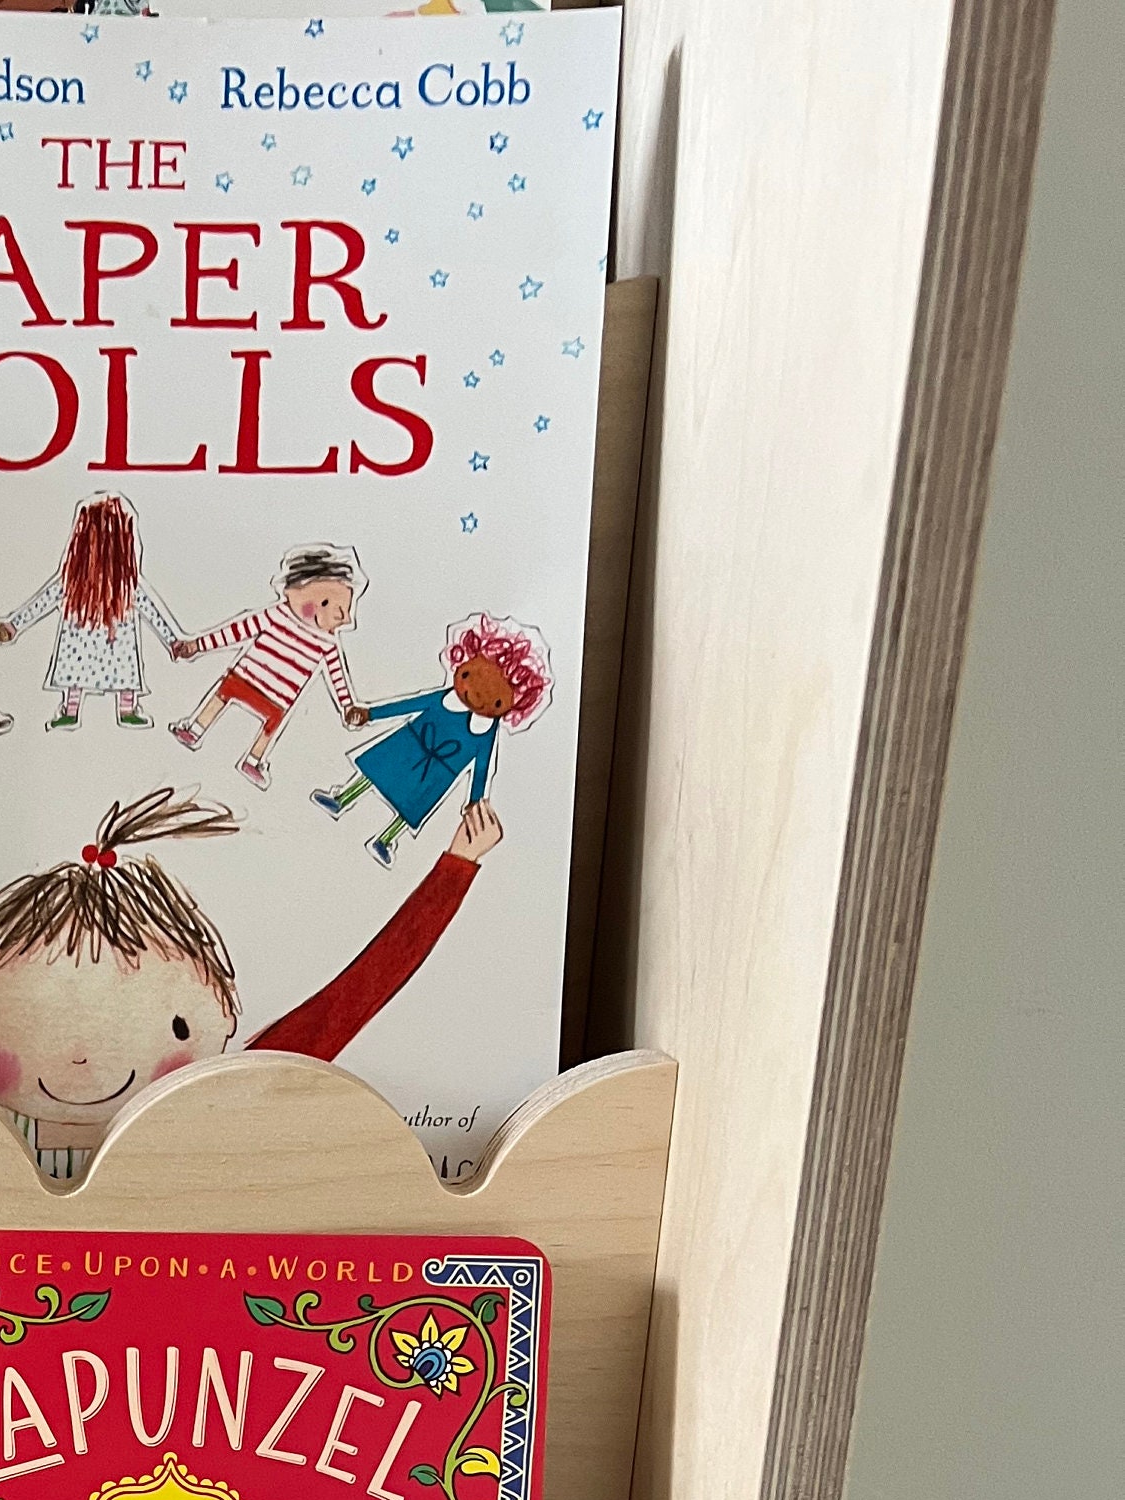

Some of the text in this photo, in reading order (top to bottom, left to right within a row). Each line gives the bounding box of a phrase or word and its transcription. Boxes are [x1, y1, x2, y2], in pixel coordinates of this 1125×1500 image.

[220, 61, 532, 110] Rebecca Cobb
[41, 137, 188, 190] THE
[458, 1105, 481, 1133] of
[84, 1250, 189, 1279] UPON
[219, 1257, 237, 1279] A
[268, 1255, 414, 1283] WORLD
